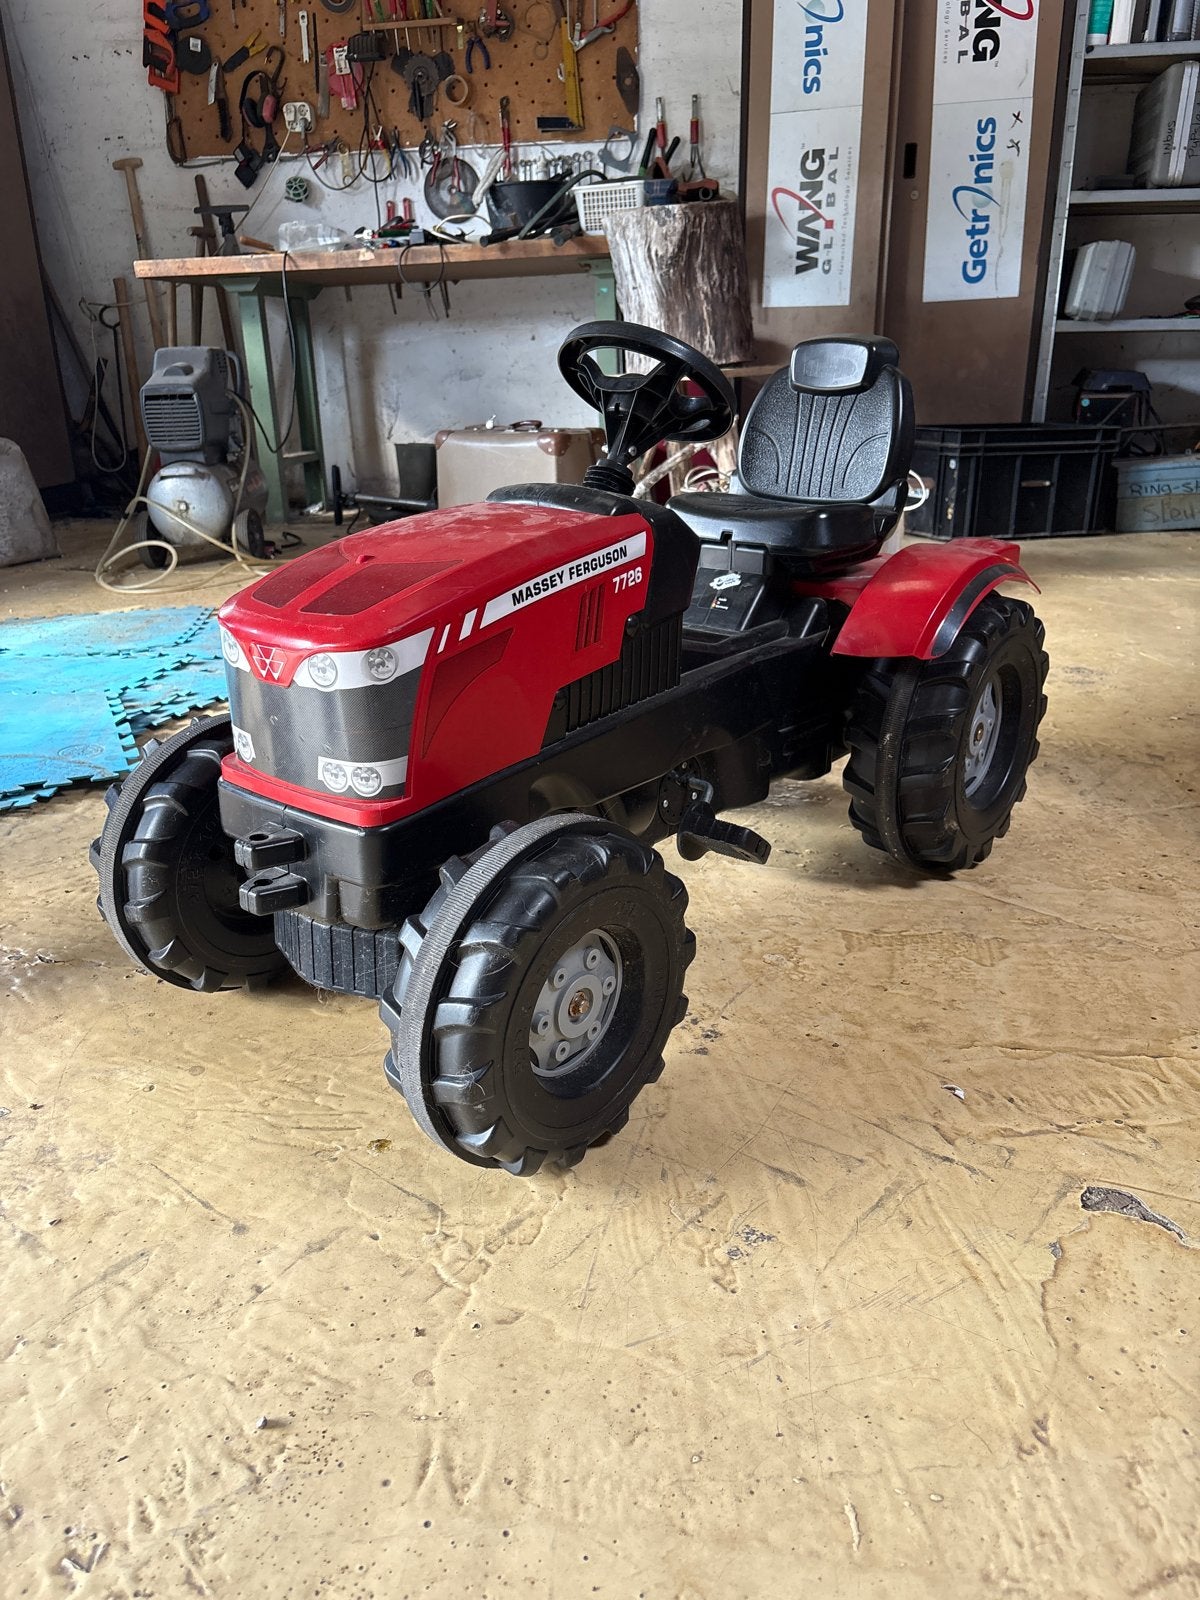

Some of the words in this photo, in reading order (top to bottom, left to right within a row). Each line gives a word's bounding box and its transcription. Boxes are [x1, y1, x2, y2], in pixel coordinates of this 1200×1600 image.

[795, 147, 826, 275] WANG
[957, 116, 998, 285] Getronics
[511, 570, 565, 606] MASSEY
[568, 545, 628, 580] FERGUSON
[612, 566, 643, 594] 7726
